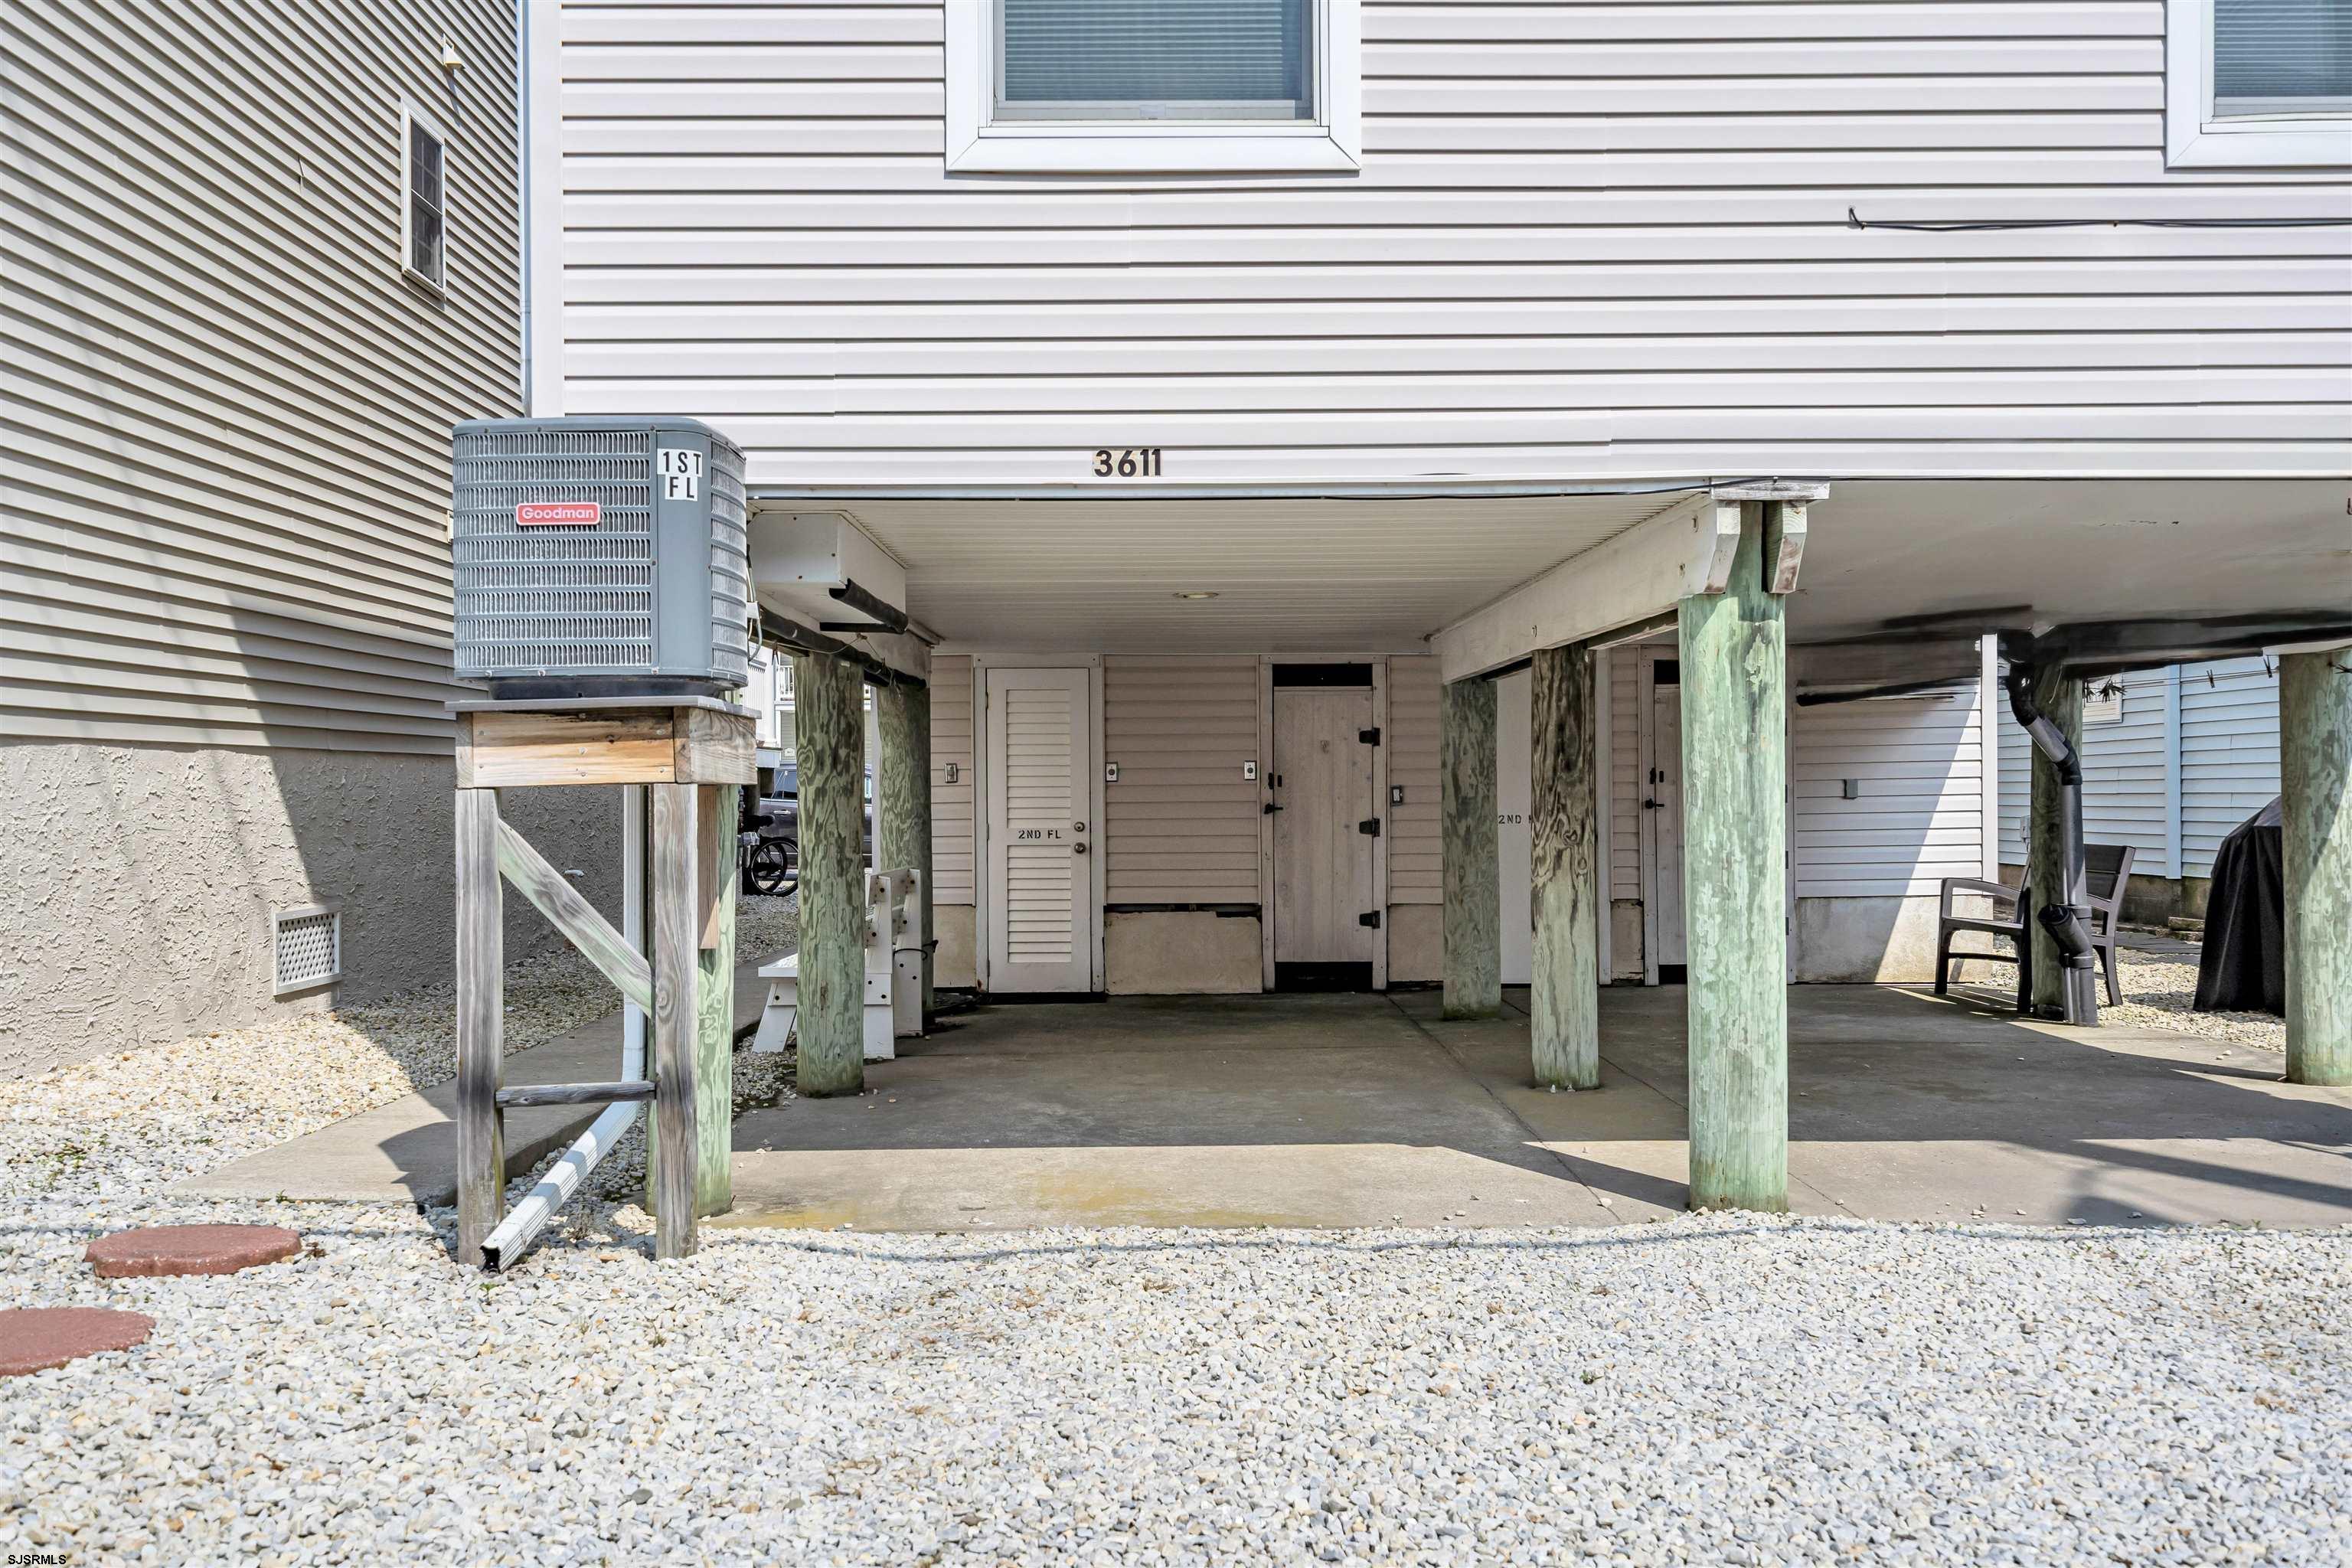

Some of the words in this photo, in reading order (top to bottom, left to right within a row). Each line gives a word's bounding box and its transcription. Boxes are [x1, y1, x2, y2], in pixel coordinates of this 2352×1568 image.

[663, 451, 701, 475] 1ST
[1094, 449, 1161, 477] 3611
[669, 476, 694, 498] FL
[521, 507, 595, 520] Goodman
[1498, 815, 1522, 825] 2ND
[1018, 829, 1041, 839] 2ND
[1047, 829, 1062, 839] FL
